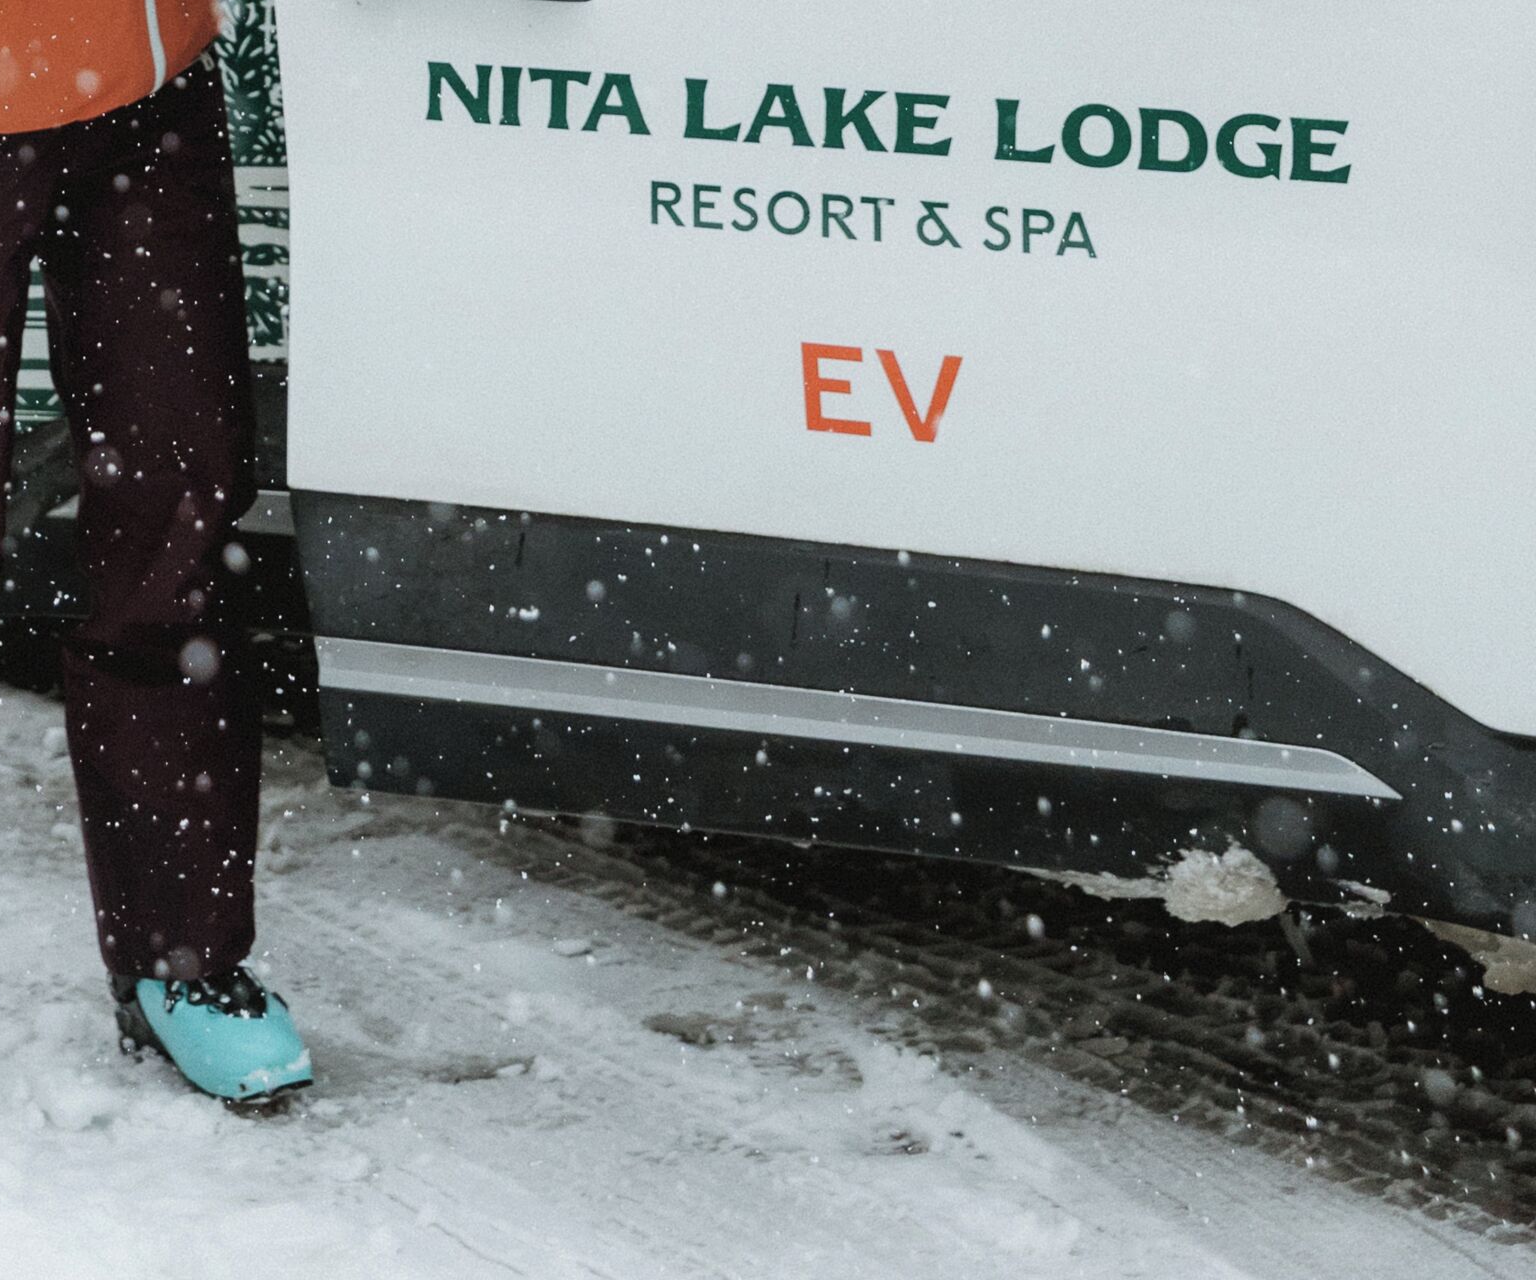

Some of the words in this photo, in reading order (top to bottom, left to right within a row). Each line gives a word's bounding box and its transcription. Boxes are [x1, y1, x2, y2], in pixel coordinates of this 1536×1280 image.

[425, 60, 652, 136] NITA
[682, 77, 954, 158] LAKE
[993, 97, 1353, 186] LODGE
[649, 180, 897, 243] RESORT
[915, 200, 963, 250] &
[981, 205, 1099, 260] SPA
[799, 341, 964, 445] EV
